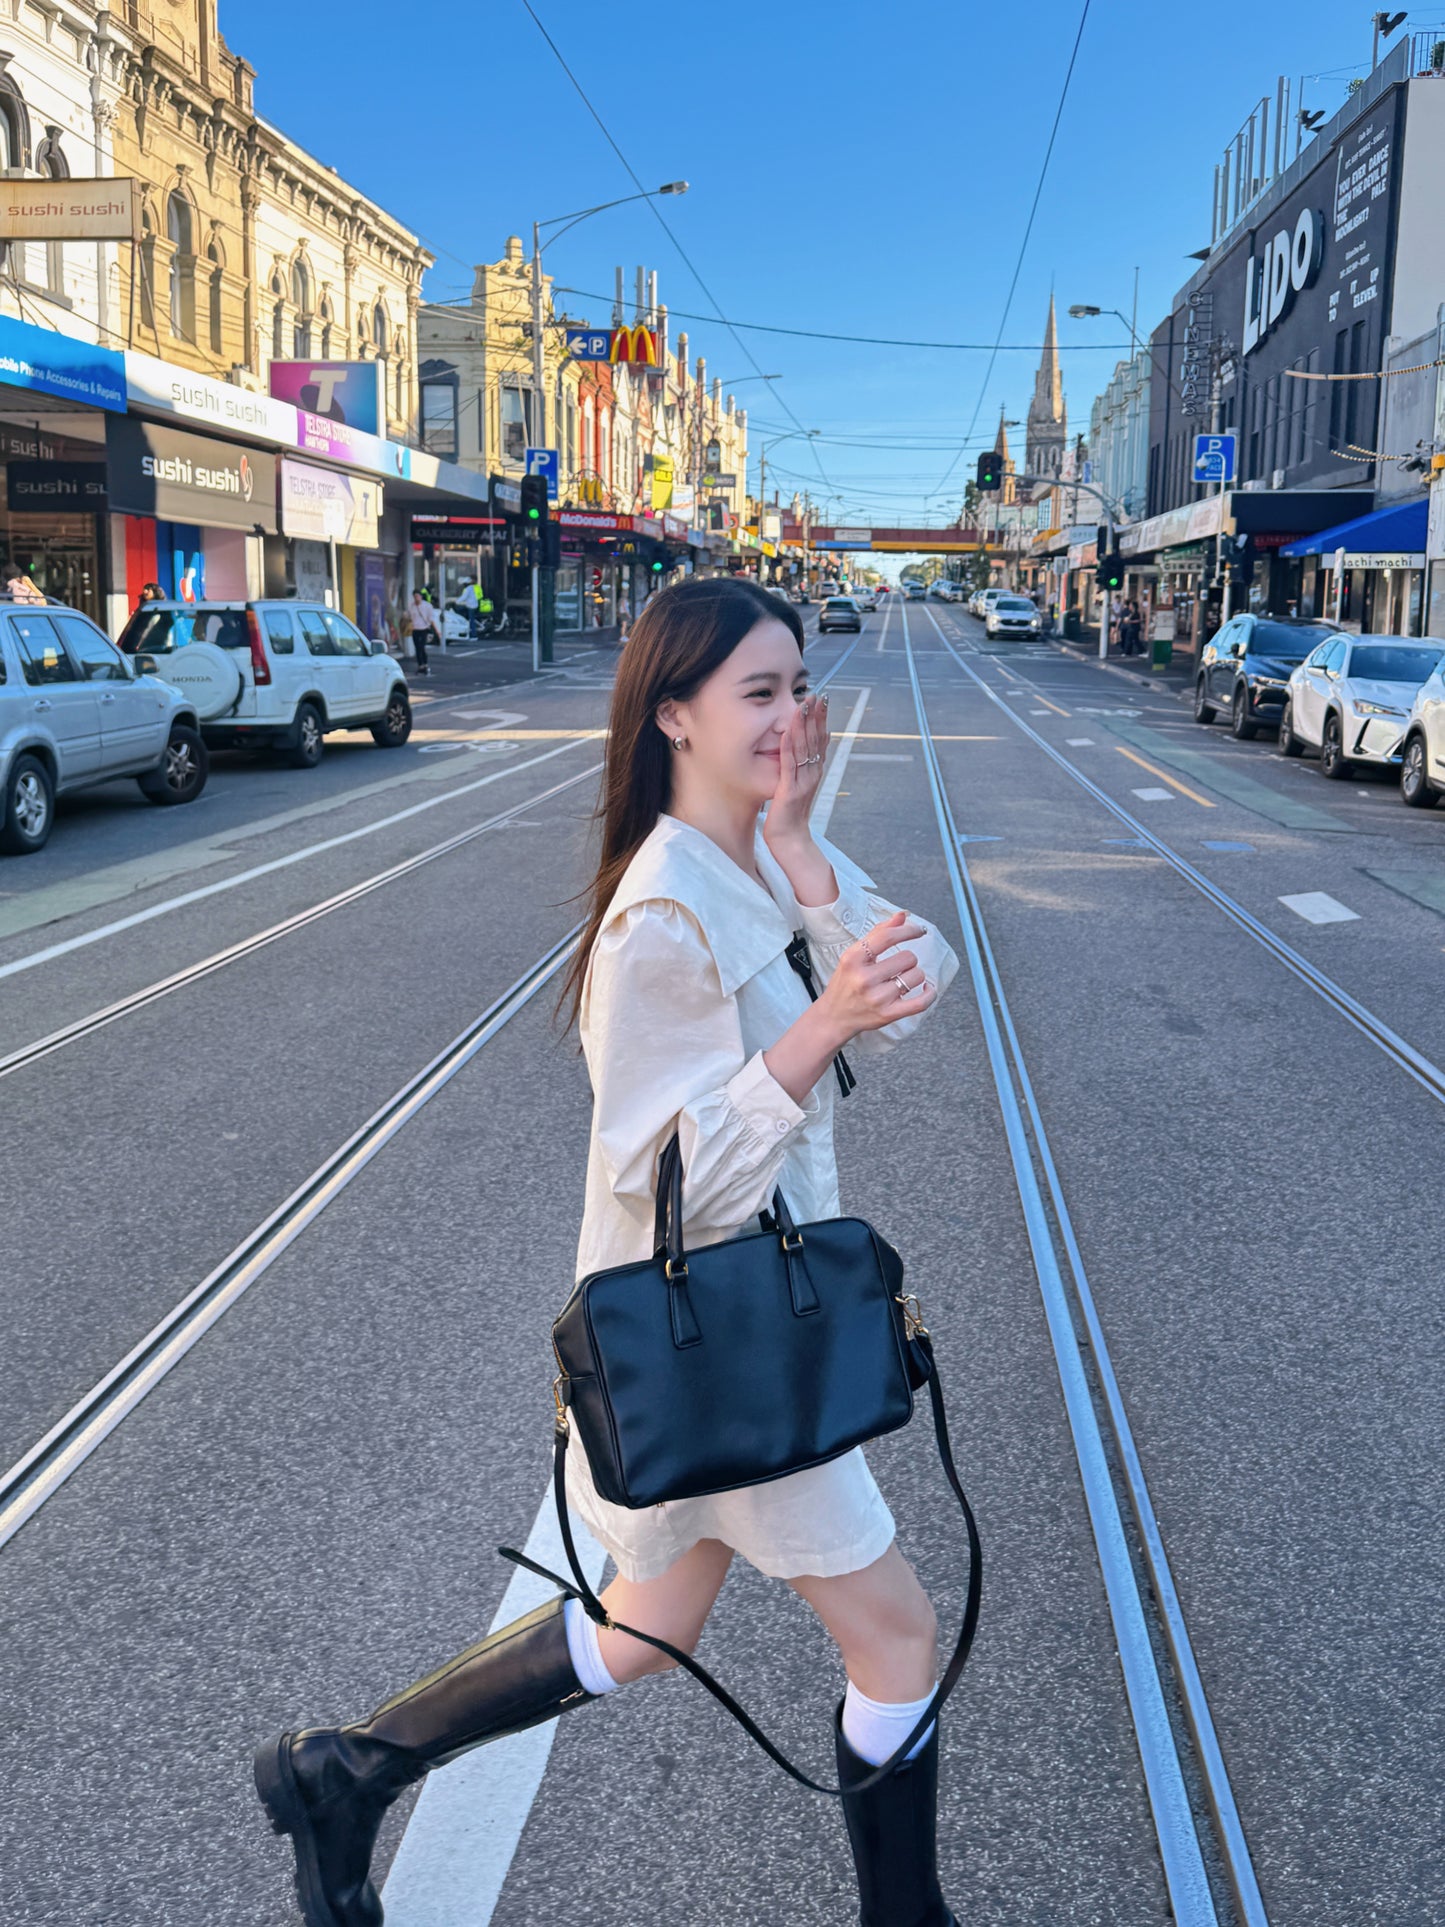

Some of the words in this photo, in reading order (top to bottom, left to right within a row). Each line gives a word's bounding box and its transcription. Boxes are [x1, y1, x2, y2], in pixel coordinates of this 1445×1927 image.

[1339, 177, 1351, 195] YOU
[1352, 163, 1366, 185] EVER
[1369, 144, 1389, 171] DANCE
[1352, 181, 1363, 200] THE
[1363, 168, 1380, 191] DEVIL
[8, 203, 63, 216] sushi
[70, 201, 125, 215] sushi
[1337, 208, 1348, 226] THE
[1371, 177, 1387, 200] PALE
[1242, 207, 1314, 356] LIDO
[592, 339, 604, 353] P
[1181, 291, 1202, 416] CINEMAS
[20, 360, 45, 380] Phone
[46, 369, 89, 392] Accessories
[90, 381, 96, 395] &
[97, 384, 122, 401] Repairs
[171, 383, 220, 413] sushi
[225, 400, 267, 426] sushi
[304, 413, 332, 439] TELSTRA
[10, 439, 54, 459] sushi
[16, 480, 78, 494] sushi
[142, 455, 192, 484] sushi
[195, 467, 240, 493] sushi
[560, 513, 617, 528] McDonald's
[1343, 556, 1371, 568] achi
[1375, 556, 1413, 568] machi
[172, 675, 213, 683] HONDA
